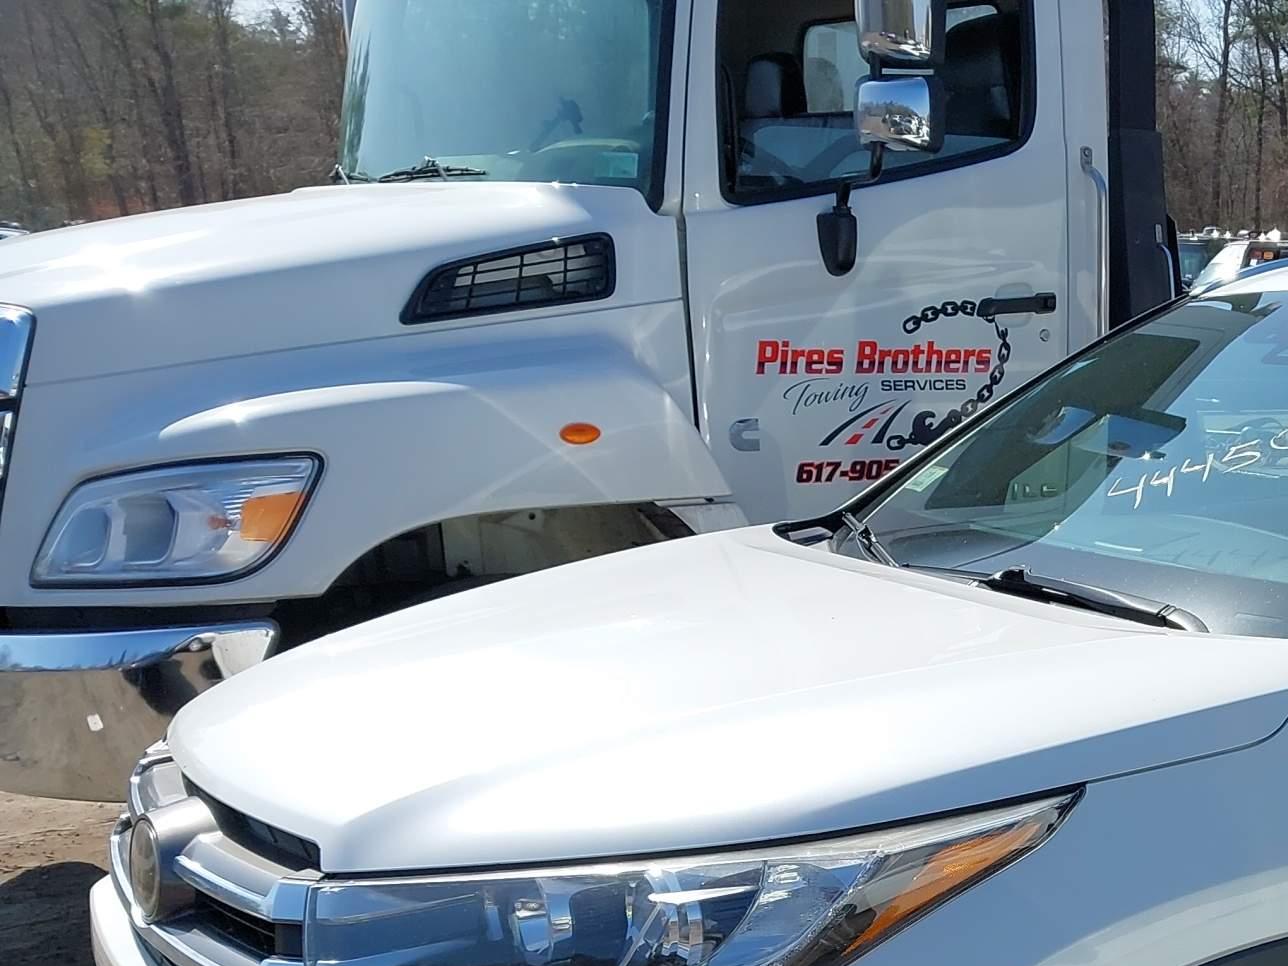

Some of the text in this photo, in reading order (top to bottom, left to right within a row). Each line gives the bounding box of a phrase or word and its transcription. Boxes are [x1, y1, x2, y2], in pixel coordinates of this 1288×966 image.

[756, 339, 992, 375] Pires Brothers
[783, 377, 967, 415] Towing SERVICES
